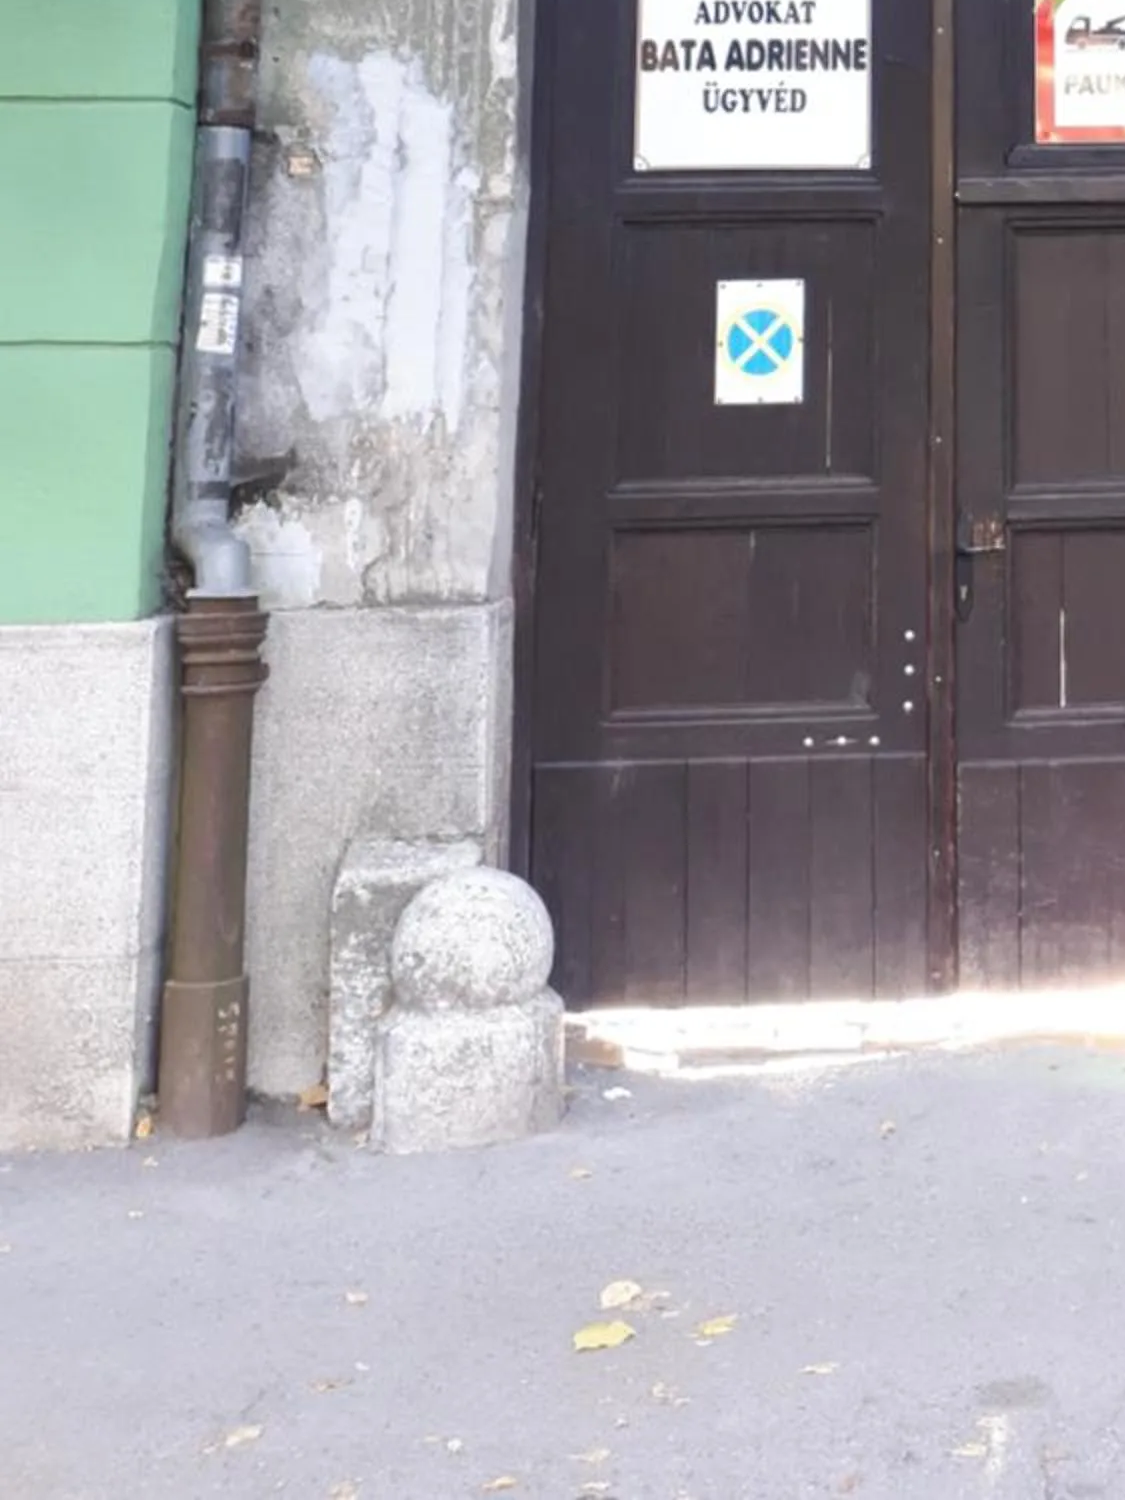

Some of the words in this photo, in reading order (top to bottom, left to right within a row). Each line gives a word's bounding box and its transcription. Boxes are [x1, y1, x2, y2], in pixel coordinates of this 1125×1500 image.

[694, 0, 816, 25] ADVOKAT
[639, 38, 717, 72] BATA
[724, 38, 868, 72] ADRIENNE
[702, 80, 807, 114] ÜGYVÉD
